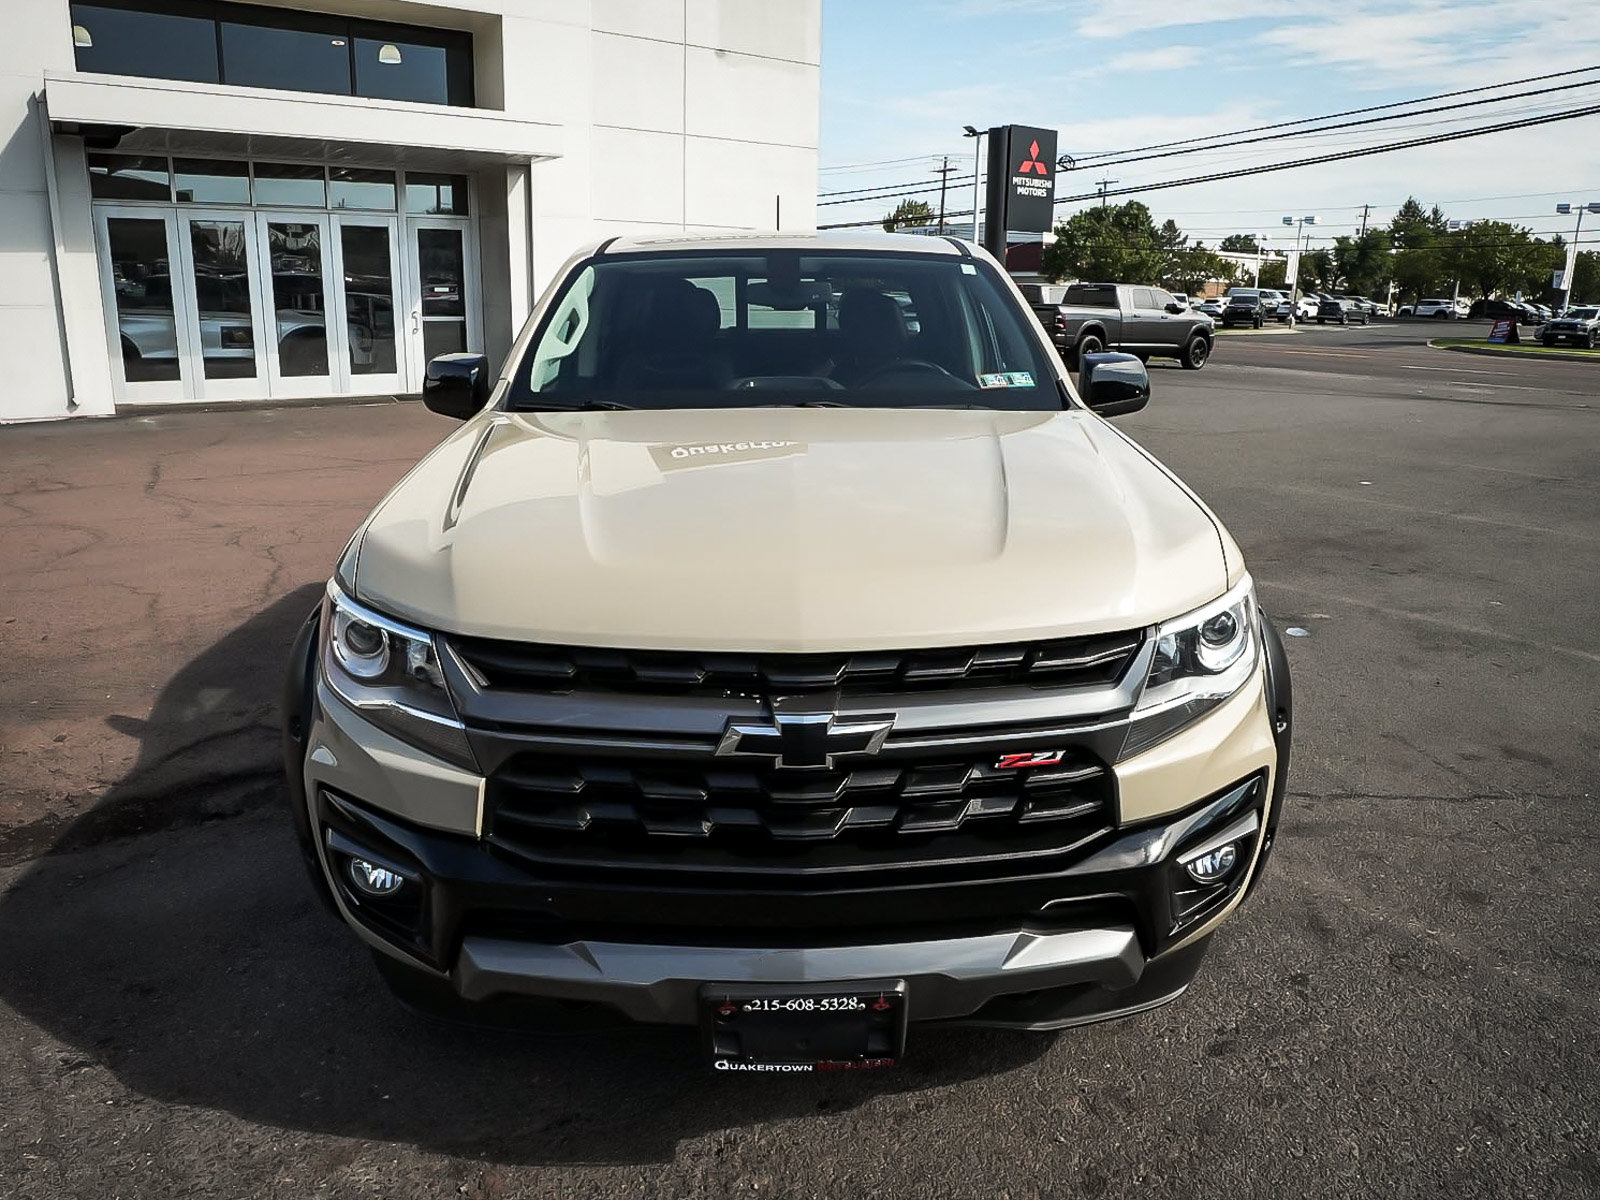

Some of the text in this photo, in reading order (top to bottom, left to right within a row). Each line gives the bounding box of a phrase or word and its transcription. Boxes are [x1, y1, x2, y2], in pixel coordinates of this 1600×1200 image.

[1012, 176, 1053, 189] MITSUBISHI
[1017, 186, 1047, 197] MOTORS
[994, 750, 1067, 769] Z71
[751, 997, 858, 1011] 215-608-5328
